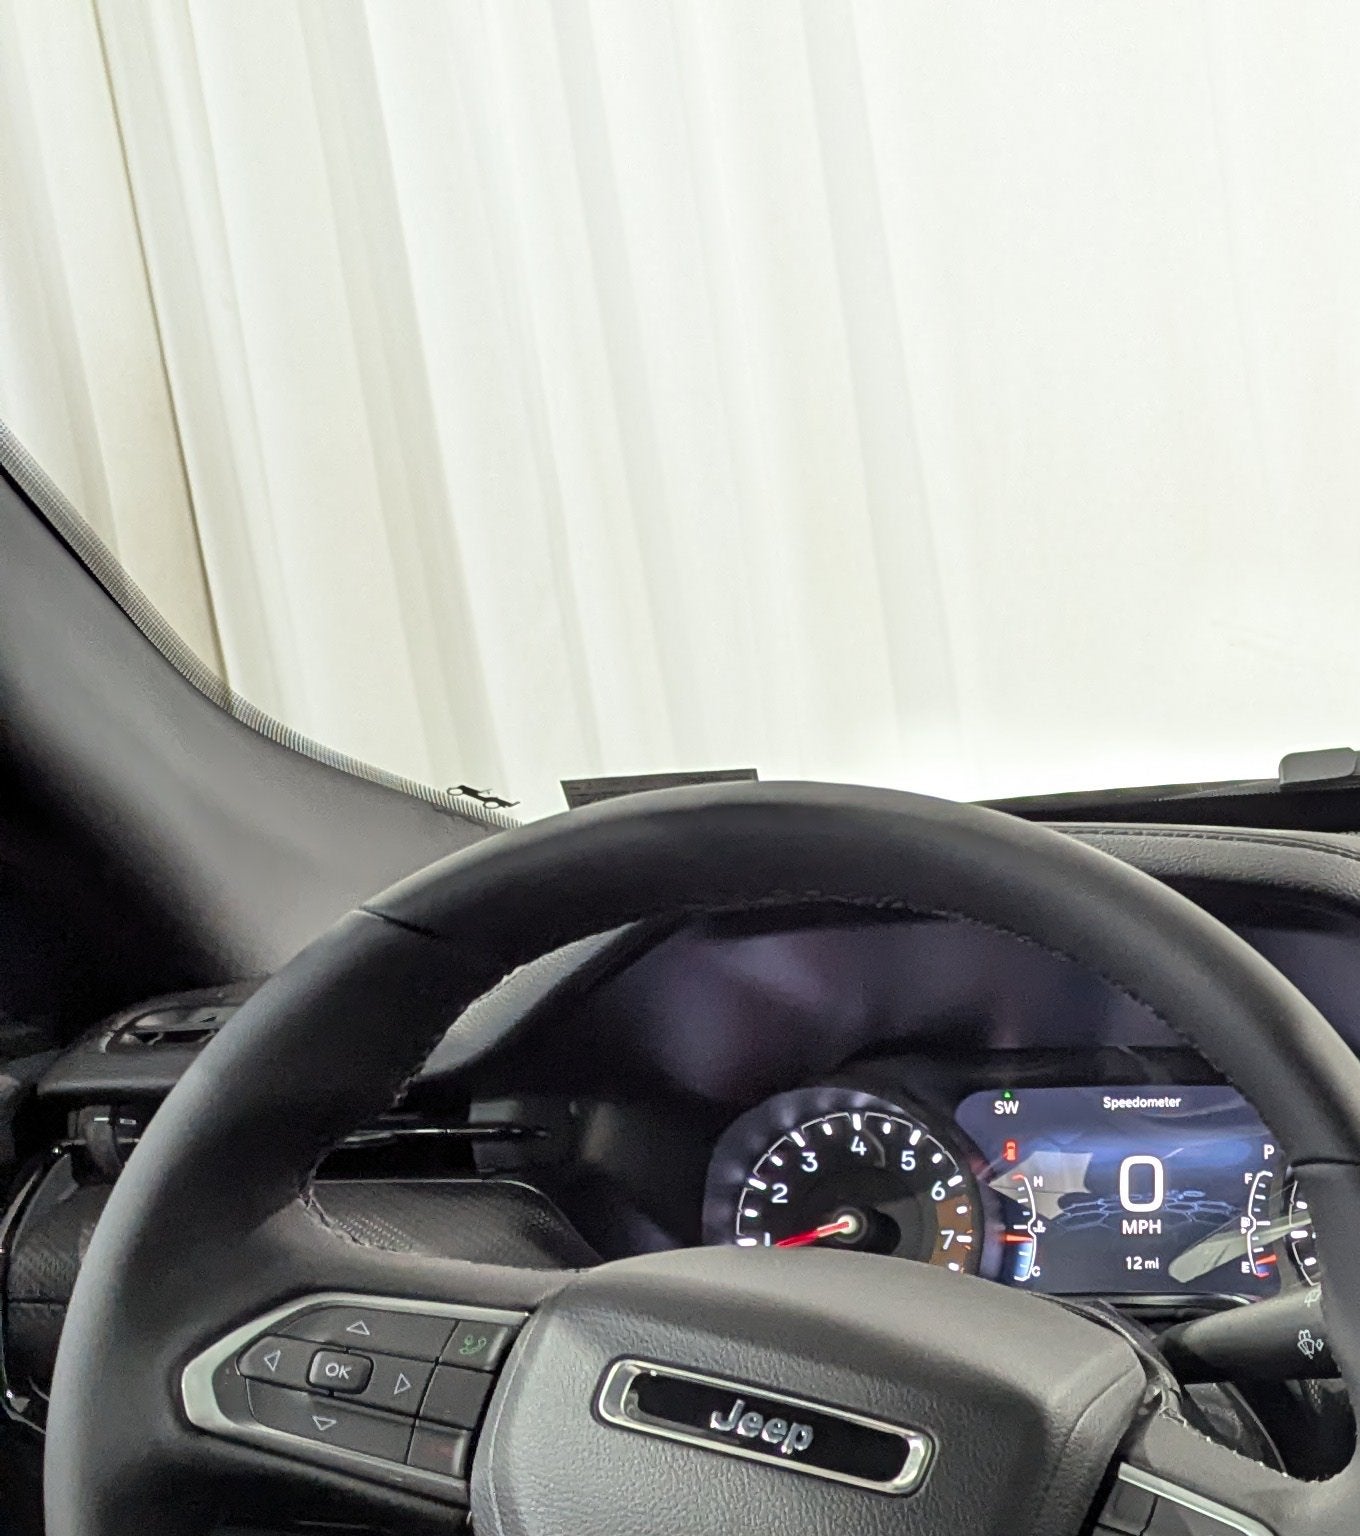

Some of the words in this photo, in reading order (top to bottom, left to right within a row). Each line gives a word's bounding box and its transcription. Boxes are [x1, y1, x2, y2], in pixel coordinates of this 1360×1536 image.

[994, 1100, 1020, 1115] SW
[1103, 1096, 1182, 1110] Speedometer
[851, 1136, 867, 1156] 4
[1263, 1144, 1274, 1160] P
[801, 1152, 818, 1172] 3
[900, 1150, 916, 1171] 5
[1034, 1176, 1044, 1188] H
[1119, 1155, 1164, 1213] 0
[1244, 1173, 1253, 1184] F
[772, 1183, 788, 1204] 2
[932, 1180, 946, 1201] 6
[1122, 1220, 1162, 1234] MPH
[764, 1232, 771, 1246] 1
[940, 1230, 955, 1250] 7
[1126, 1256, 1142, 1270] 12
[1144, 1257, 1160, 1270] mi
[1242, 1262, 1250, 1274] E
[325, 1362, 352, 1381] OK
[710, 1399, 814, 1455] Jeep
